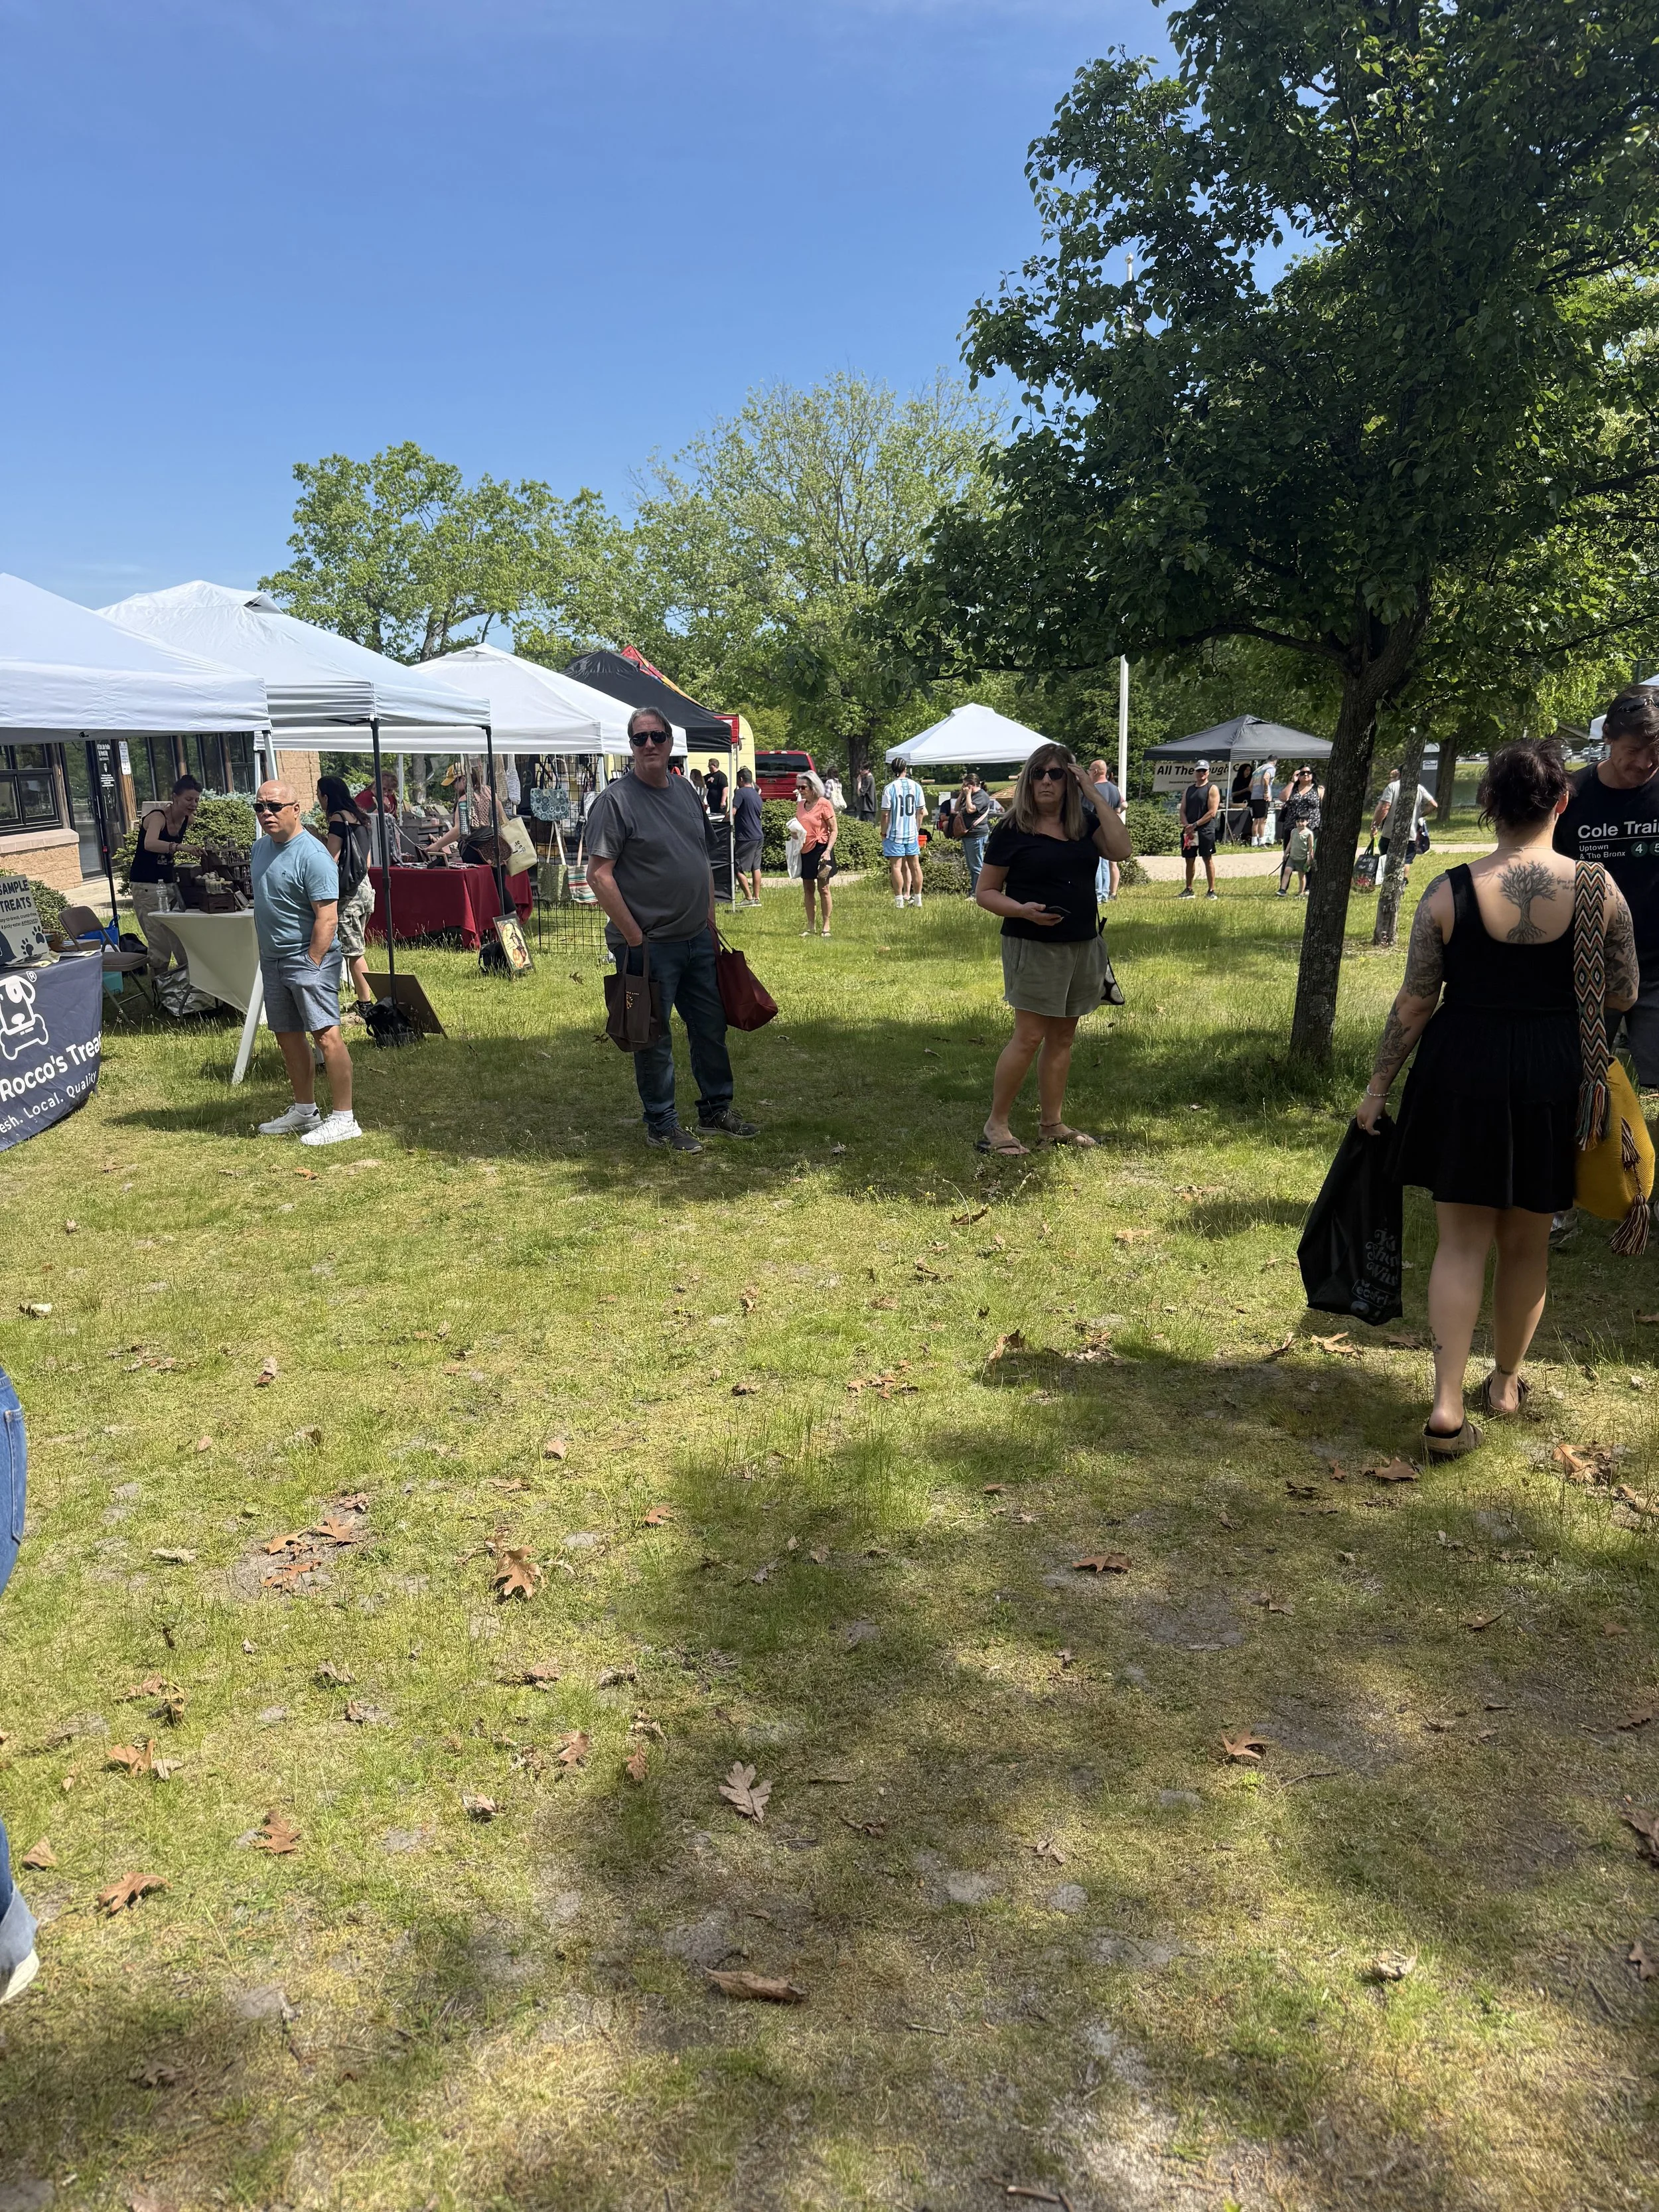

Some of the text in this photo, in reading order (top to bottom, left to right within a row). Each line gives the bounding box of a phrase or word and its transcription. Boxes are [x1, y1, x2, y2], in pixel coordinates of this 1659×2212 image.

[1157, 765, 1172, 775] All
[1175, 766, 1194, 775] The
[1208, 765, 1228, 776] ugh
[899, 794, 915, 816] 10
[1577, 819, 1659, 839] Cole Trai
[1579, 844, 1609, 853] Uptown
[1635, 844, 1643, 853] 4
[0, 897, 32, 913] TREATS
[0, 1031, 102, 1102] Rocco's Treat
[0, 1070, 97, 1133] esh. Local. Quality
